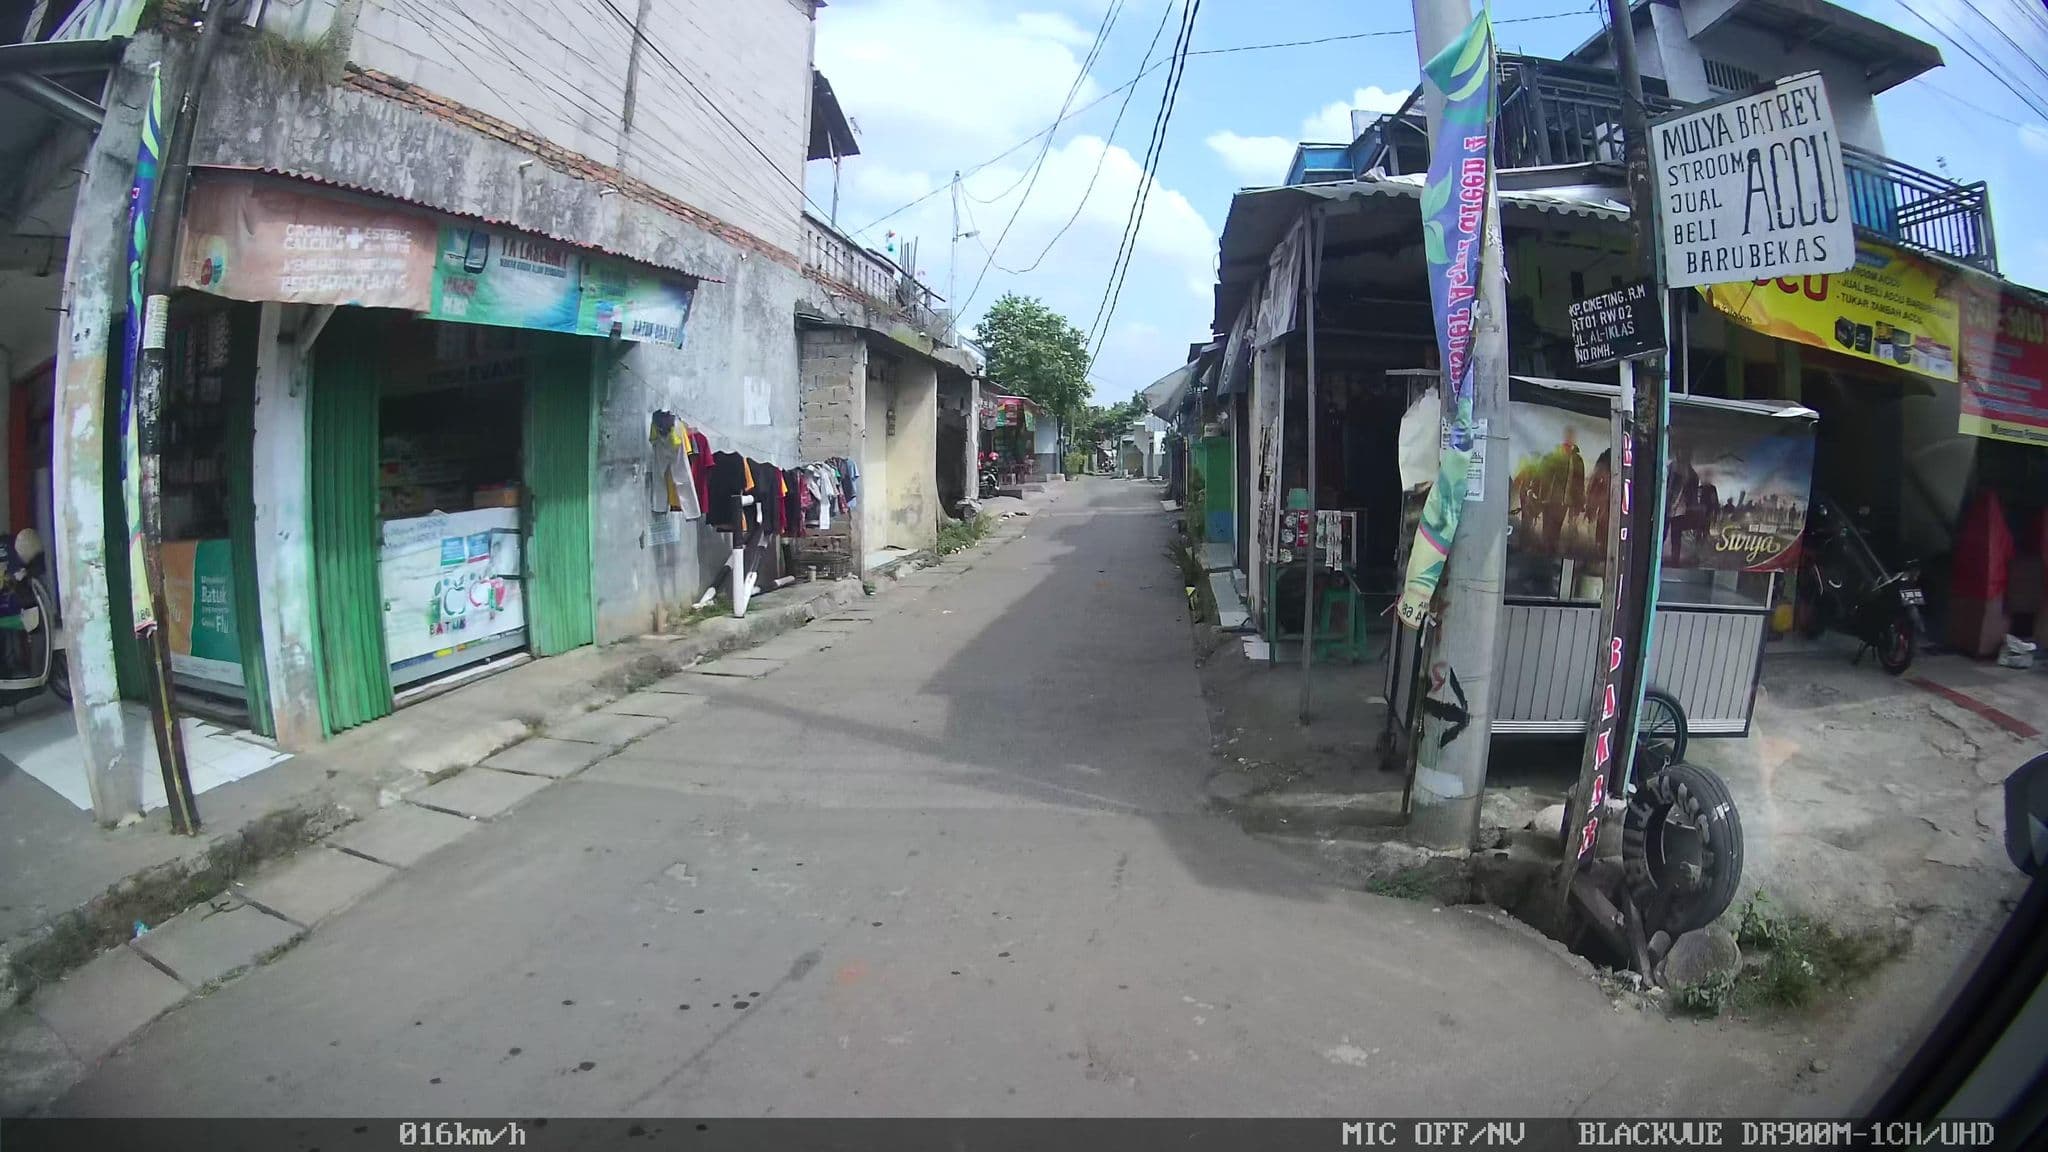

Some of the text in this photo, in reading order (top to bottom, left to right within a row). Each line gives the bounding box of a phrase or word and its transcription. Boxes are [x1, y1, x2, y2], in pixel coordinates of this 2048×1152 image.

[1662, 86, 1821, 161] MULYA BATREY
[1667, 149, 1744, 187] STROOM
[1742, 131, 1839, 236] ACCU
[1671, 188, 1723, 214] JUAL
[286, 223, 345, 239] ORGANIC
[1674, 219, 1718, 245] BELI
[1841, 292, 1869, 309] TUKAR
[1715, 524, 1781, 562] Surya
